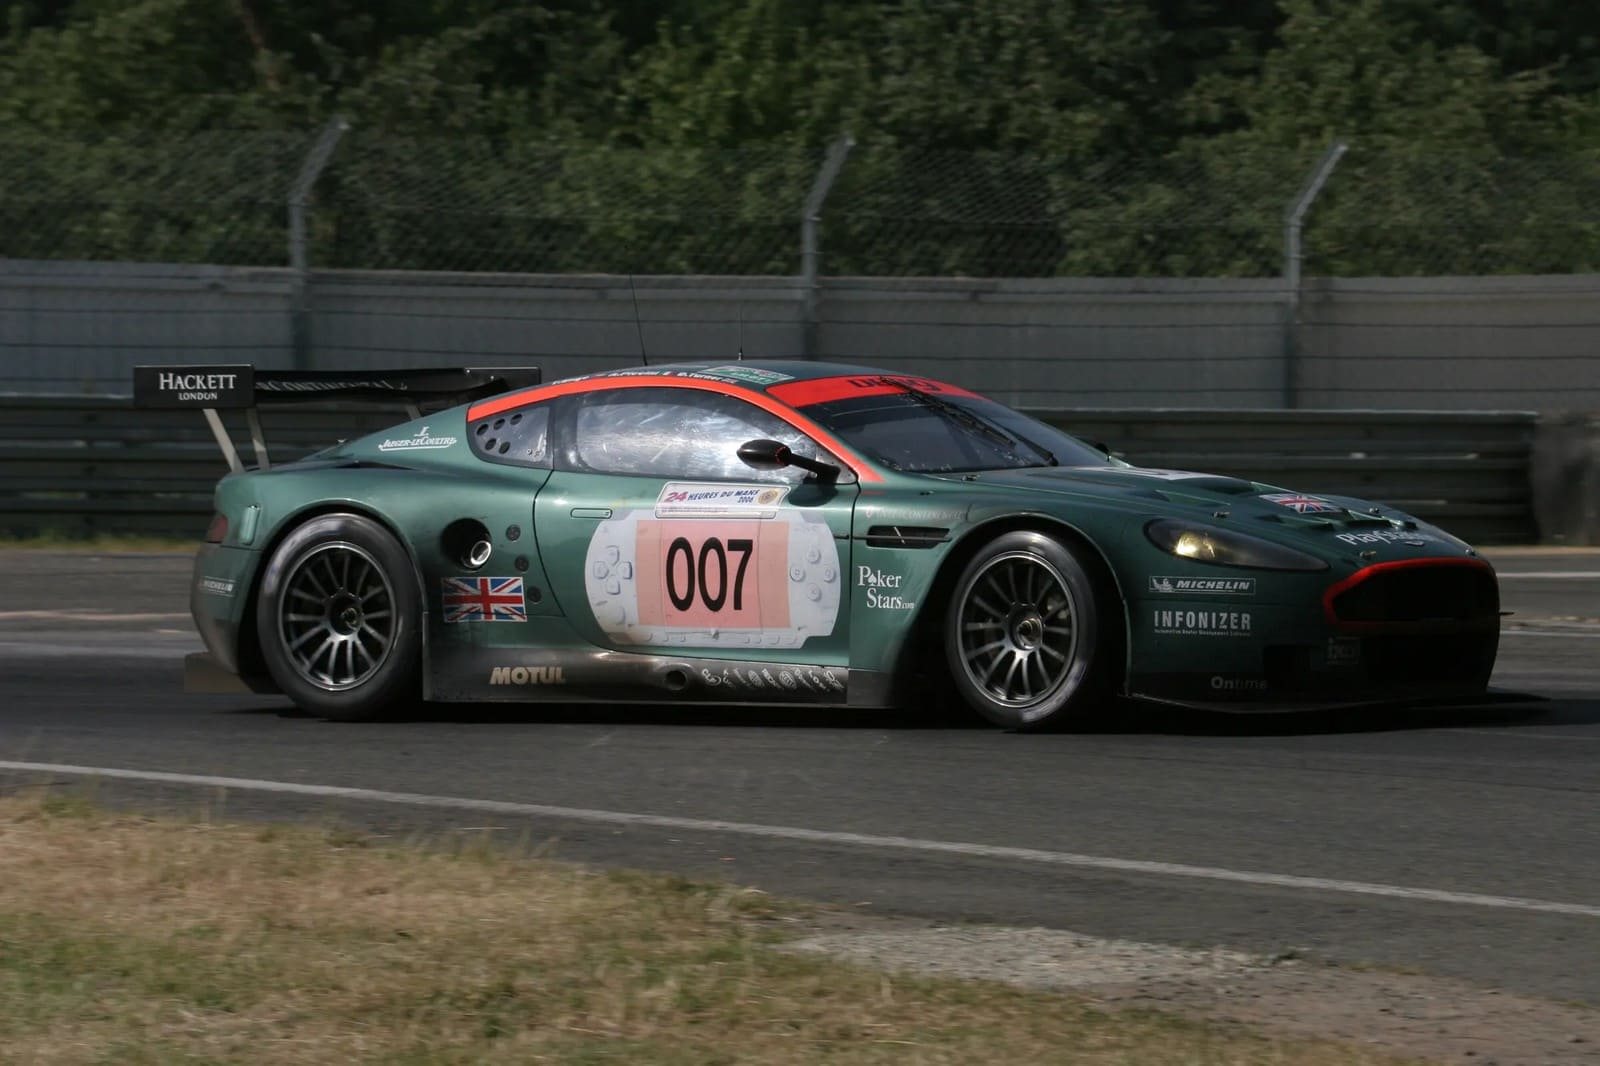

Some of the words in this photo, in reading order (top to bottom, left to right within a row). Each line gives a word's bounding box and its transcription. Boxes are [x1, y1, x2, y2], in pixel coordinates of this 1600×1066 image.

[159, 372, 237, 390] HACKETT
[178, 391, 218, 401] LONDON
[663, 491, 688, 503] 24
[687, 491, 719, 501] HEURES
[734, 489, 760, 497] MANS
[666, 537, 753, 612] 007
[1175, 580, 1250, 590] MICHELIN
[1153, 610, 1251, 630] INFONIZER
[489, 666, 566, 685] MOTUL
